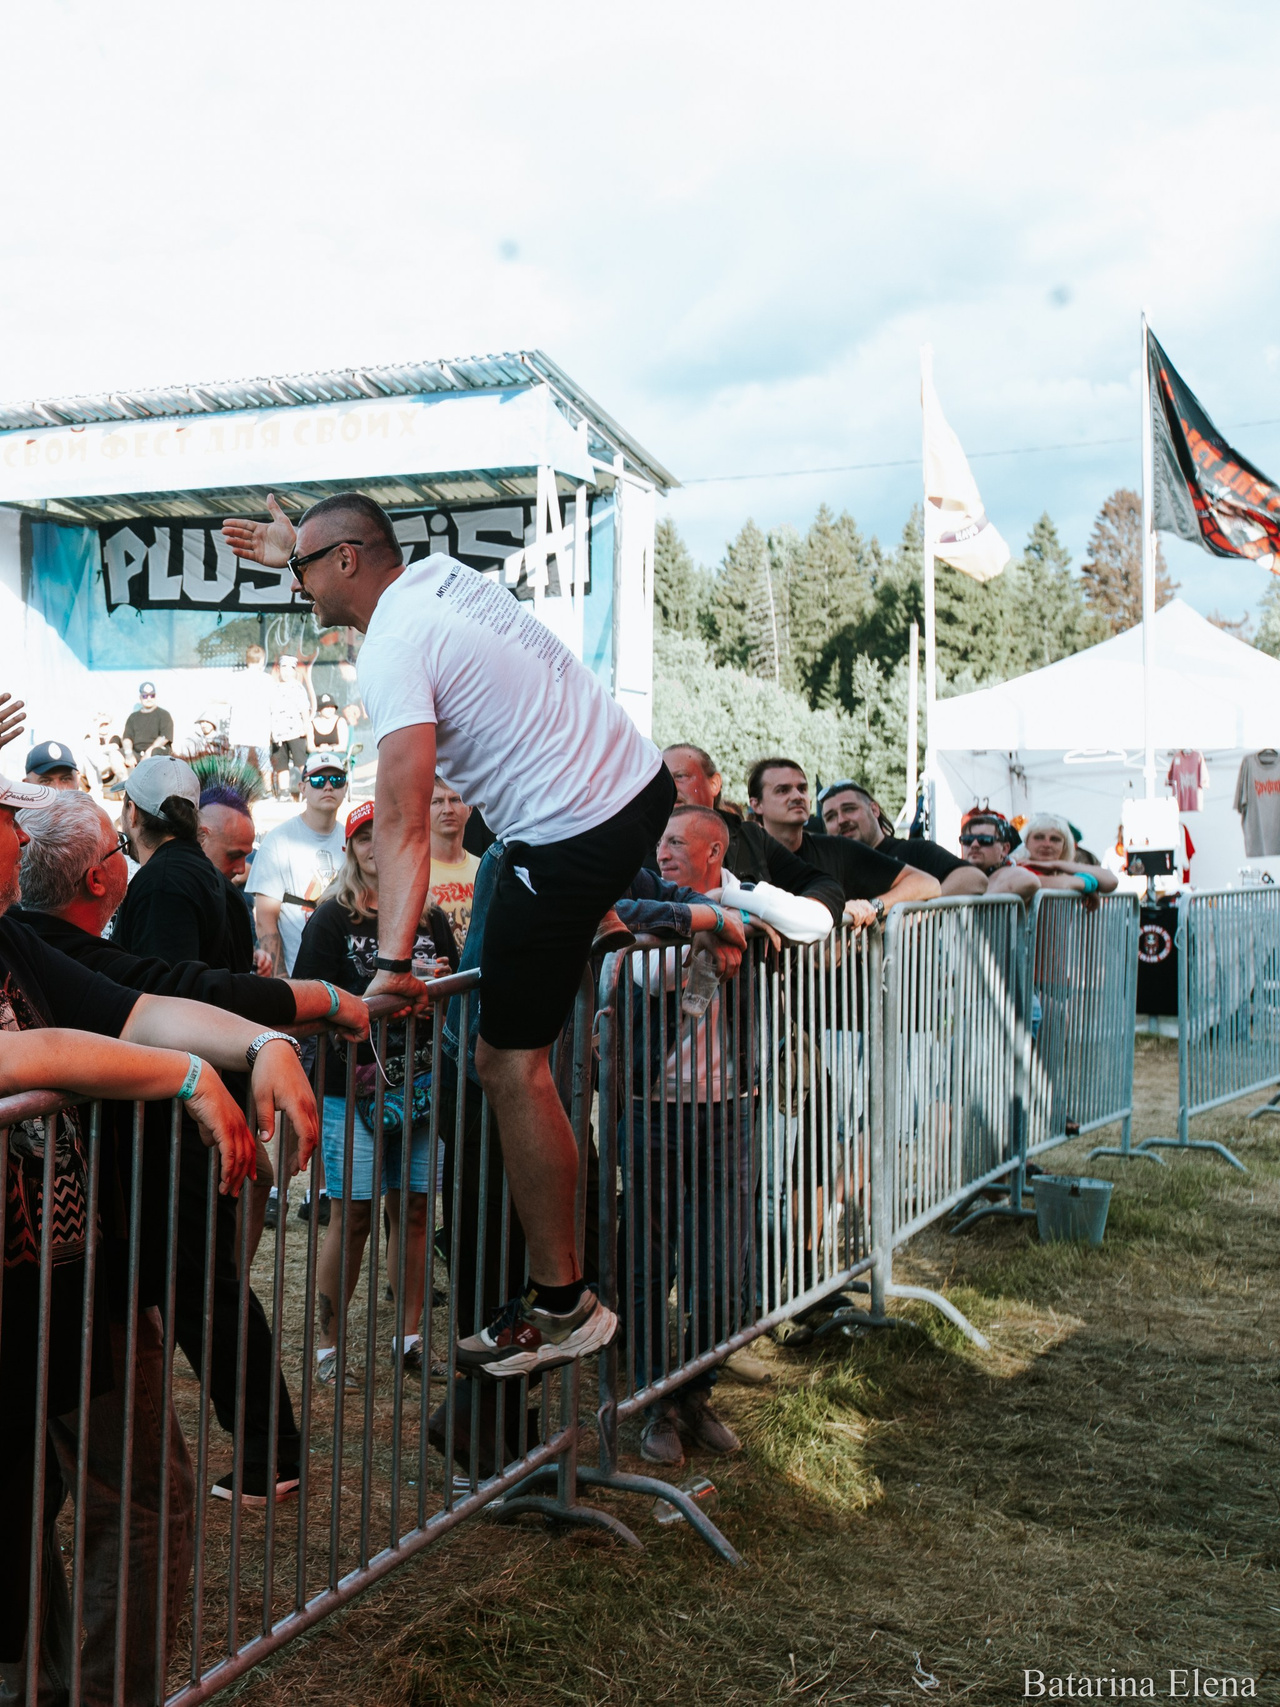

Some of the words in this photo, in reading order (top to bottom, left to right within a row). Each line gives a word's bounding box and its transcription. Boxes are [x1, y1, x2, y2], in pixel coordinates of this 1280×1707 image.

[3, 426, 88, 467] СВОЙ
[100, 427, 192, 460] ФЕСТ
[204, 421, 280, 455] ДЛЯ
[293, 408, 419, 446] СВОИХ
